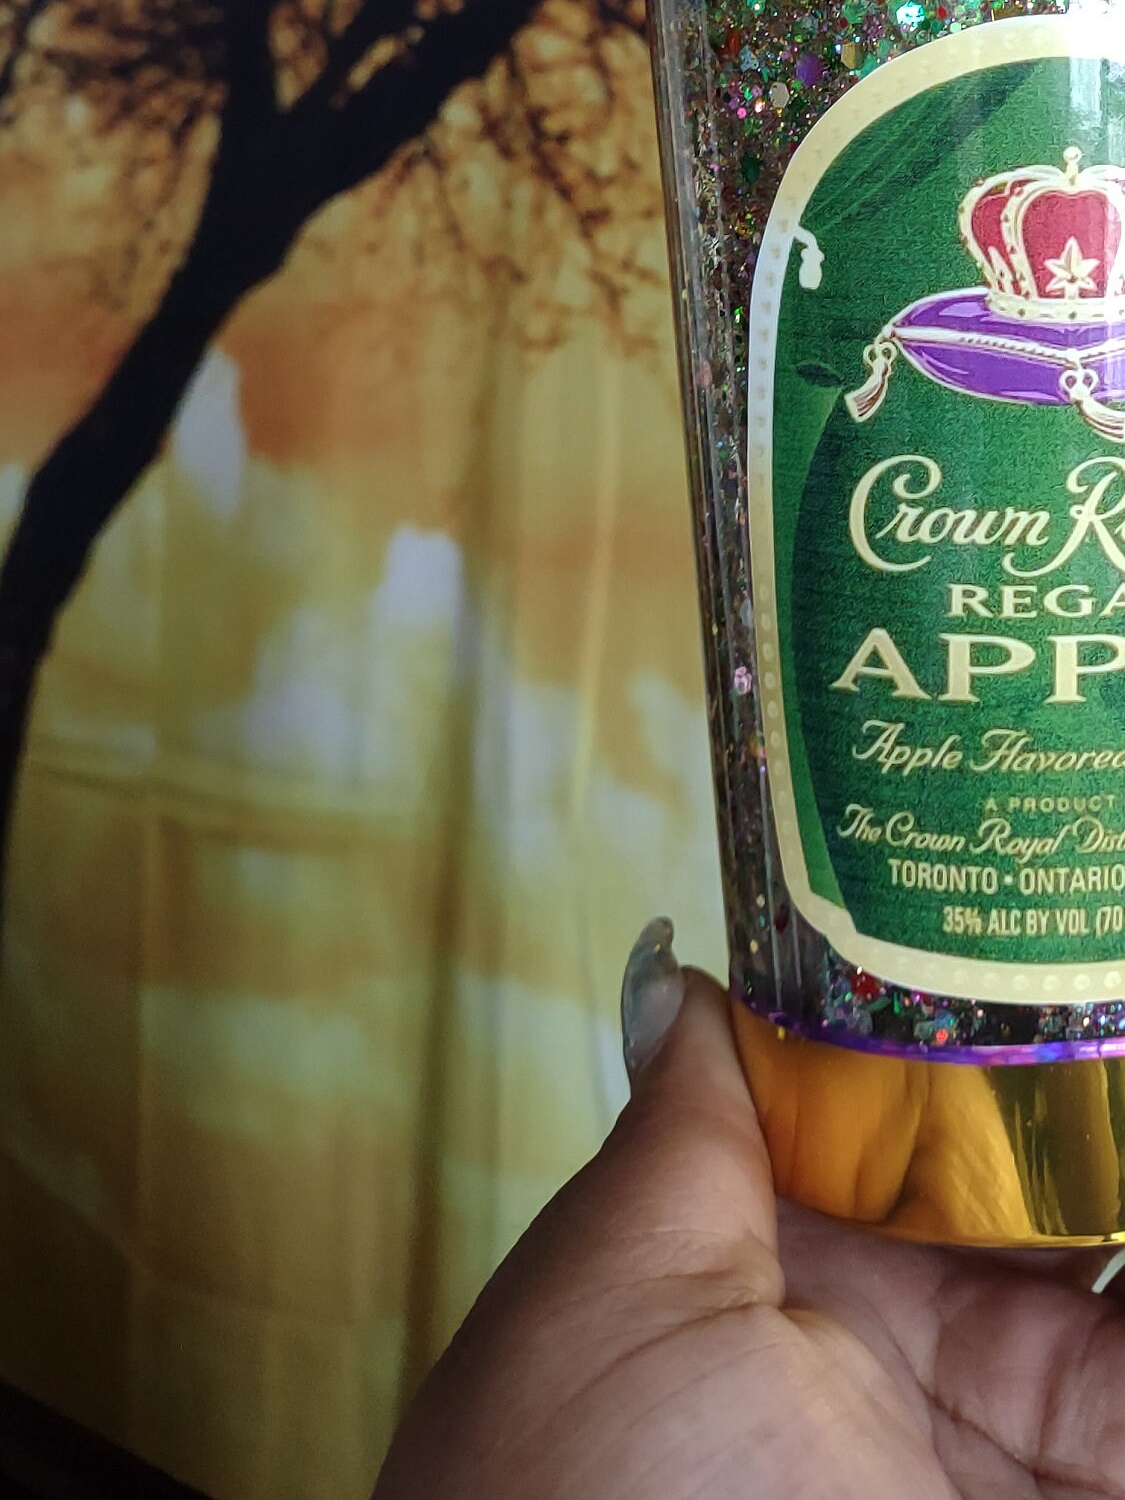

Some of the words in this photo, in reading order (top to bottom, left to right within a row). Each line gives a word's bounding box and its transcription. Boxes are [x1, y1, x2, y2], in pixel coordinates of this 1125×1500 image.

[849, 455, 1050, 573] Crown
[853, 718, 962, 776] Apple
[984, 796, 999, 813] A
[1008, 794, 1116, 813] PRODUCT
[836, 803, 883, 843] The
[886, 811, 967, 852] Crown
[969, 818, 1072, 864] Royal
[888, 858, 999, 896] TORONTO
[943, 905, 982, 935] 35%
[987, 907, 1022, 936] ALC
[1025, 908, 1051, 936] BY
[1056, 907, 1090, 936] VOL
[1096, 905, 1123, 939] (70
